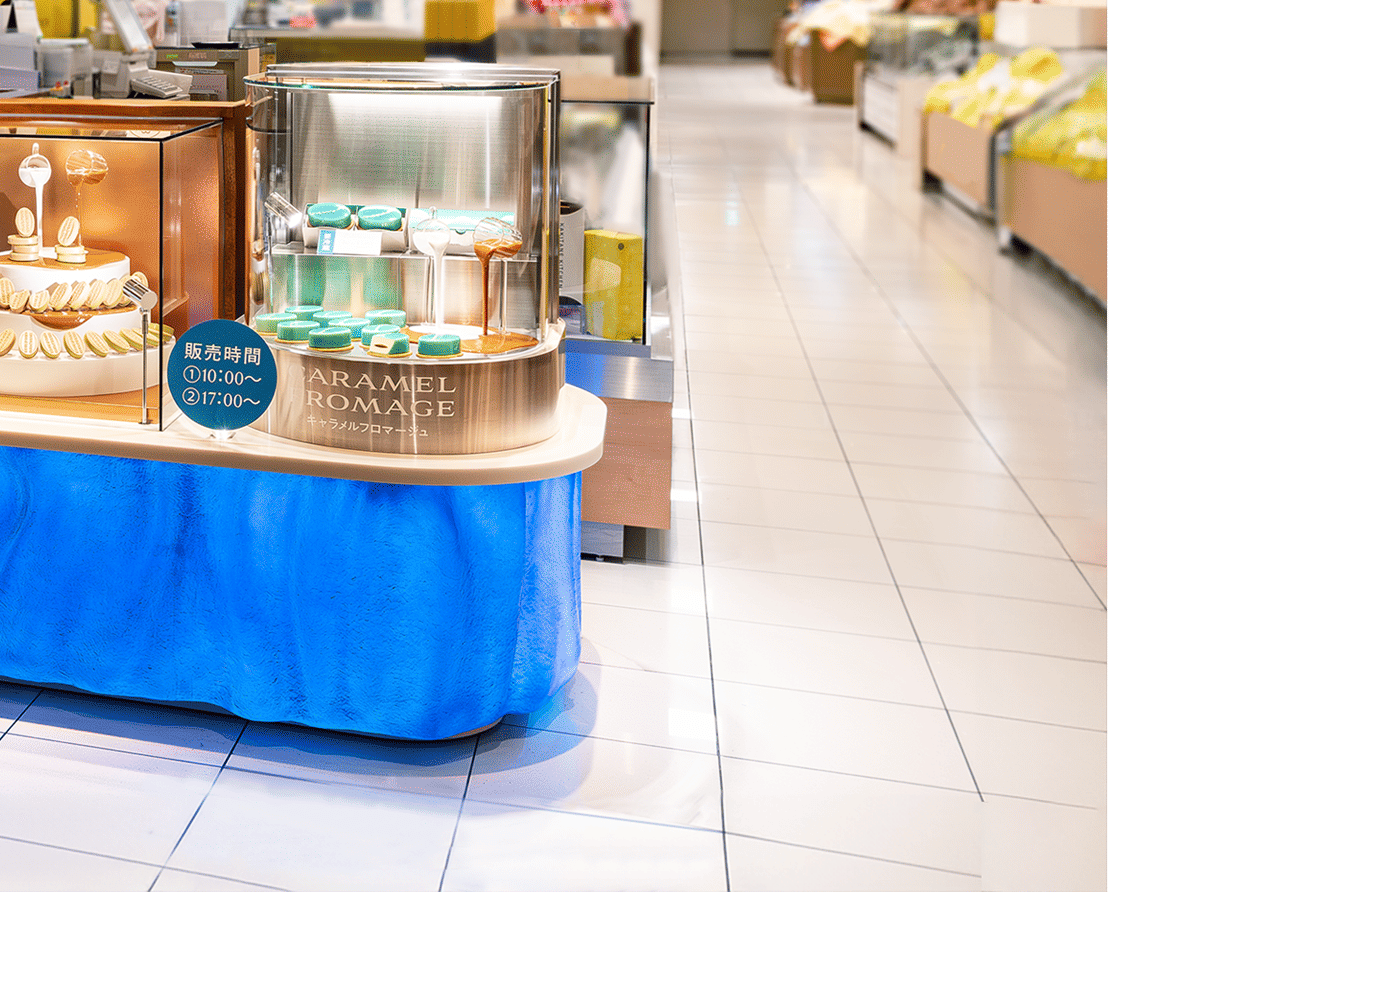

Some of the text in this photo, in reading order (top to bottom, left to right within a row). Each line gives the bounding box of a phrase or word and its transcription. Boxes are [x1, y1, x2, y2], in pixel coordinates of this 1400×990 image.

[184, 342, 261, 366] 販売時間
[306, 389, 456, 417] ROMAGE
[306, 414, 429, 438] キャラメルフロマージュ
